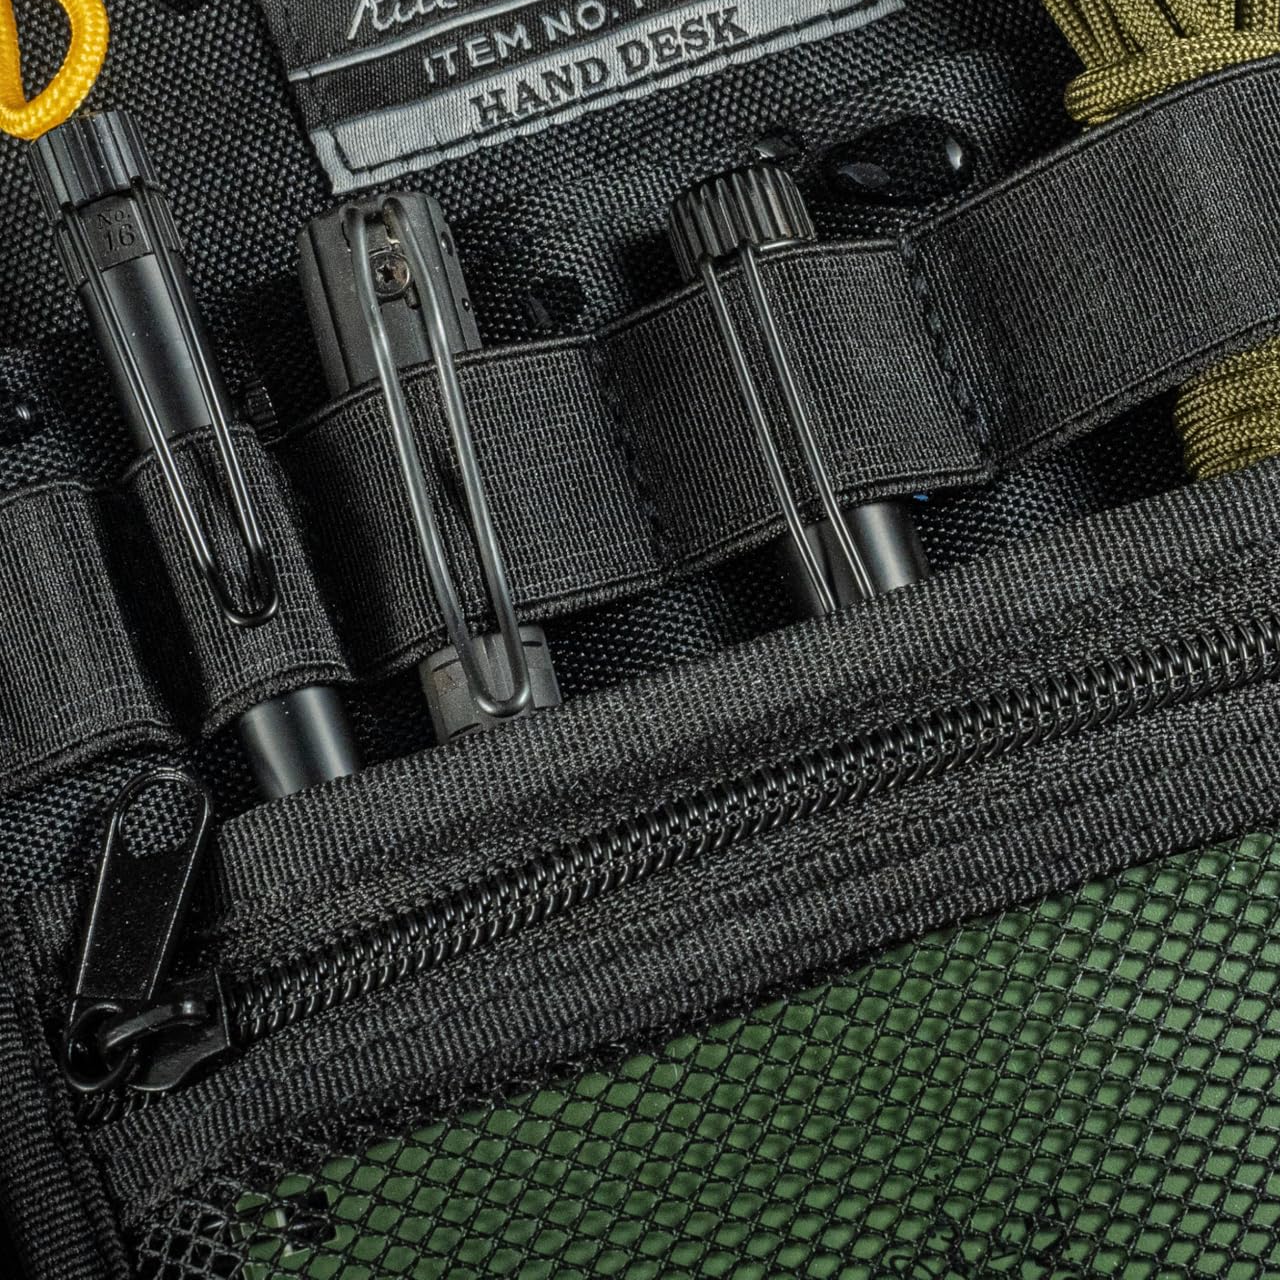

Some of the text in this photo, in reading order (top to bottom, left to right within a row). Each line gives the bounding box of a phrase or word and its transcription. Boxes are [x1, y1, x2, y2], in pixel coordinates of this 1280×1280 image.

[423, 24, 532, 83] ITEM
[542, 0, 620, 42] NO.
[469, 6, 751, 131] HAND DESK
